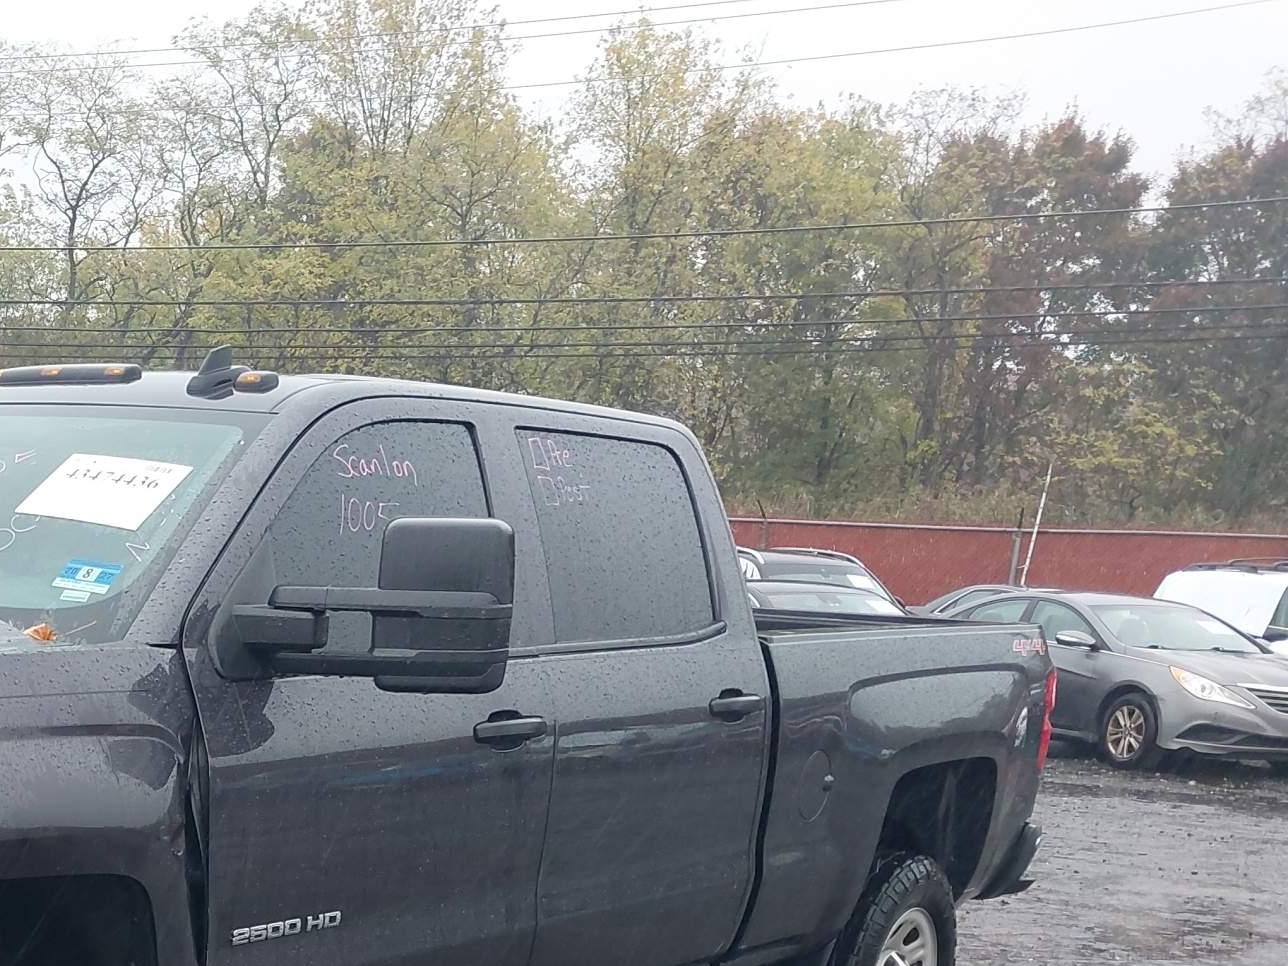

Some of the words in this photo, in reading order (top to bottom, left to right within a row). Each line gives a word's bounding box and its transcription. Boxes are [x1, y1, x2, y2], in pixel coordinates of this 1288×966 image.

[333, 443, 418, 486] Scanlon
[82, 568, 94, 579] 8
[231, 918, 302, 946] 2500
[306, 910, 342, 932] HD
